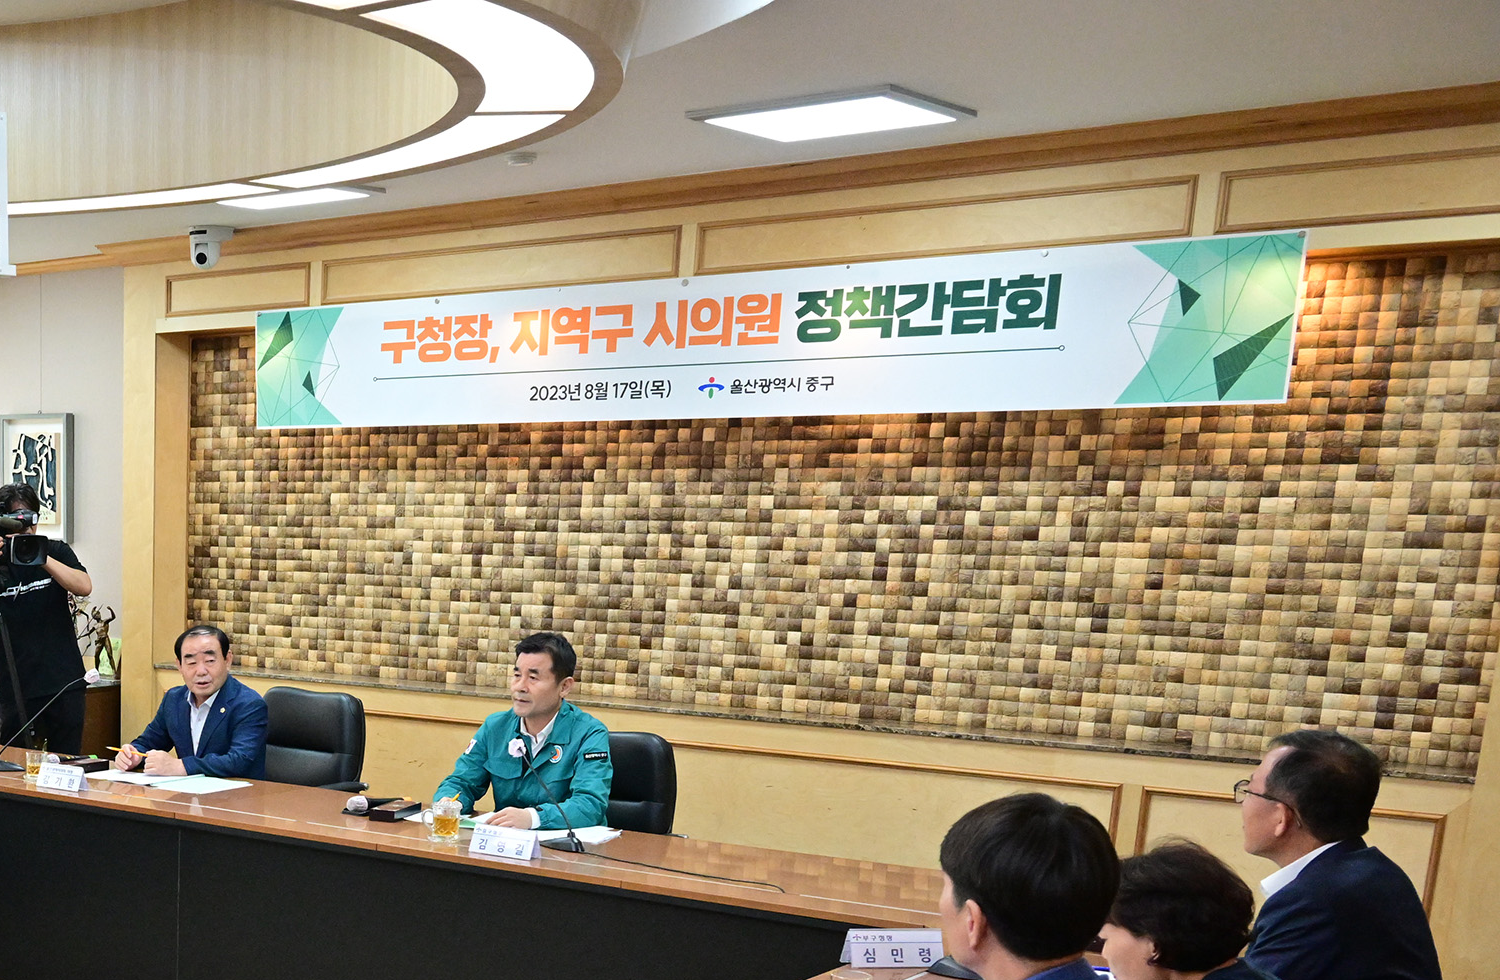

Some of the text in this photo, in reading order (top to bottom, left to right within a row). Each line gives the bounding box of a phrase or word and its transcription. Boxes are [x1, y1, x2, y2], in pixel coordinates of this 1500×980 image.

[380, 273, 1063, 365] 구청장, 지역구 시의원 정책간담회
[529, 379, 673, 401] 2023년 8월 17일(목)
[730, 376, 836, 395] 울산광역시 중구
[863, 948, 932, 964] 심민령
